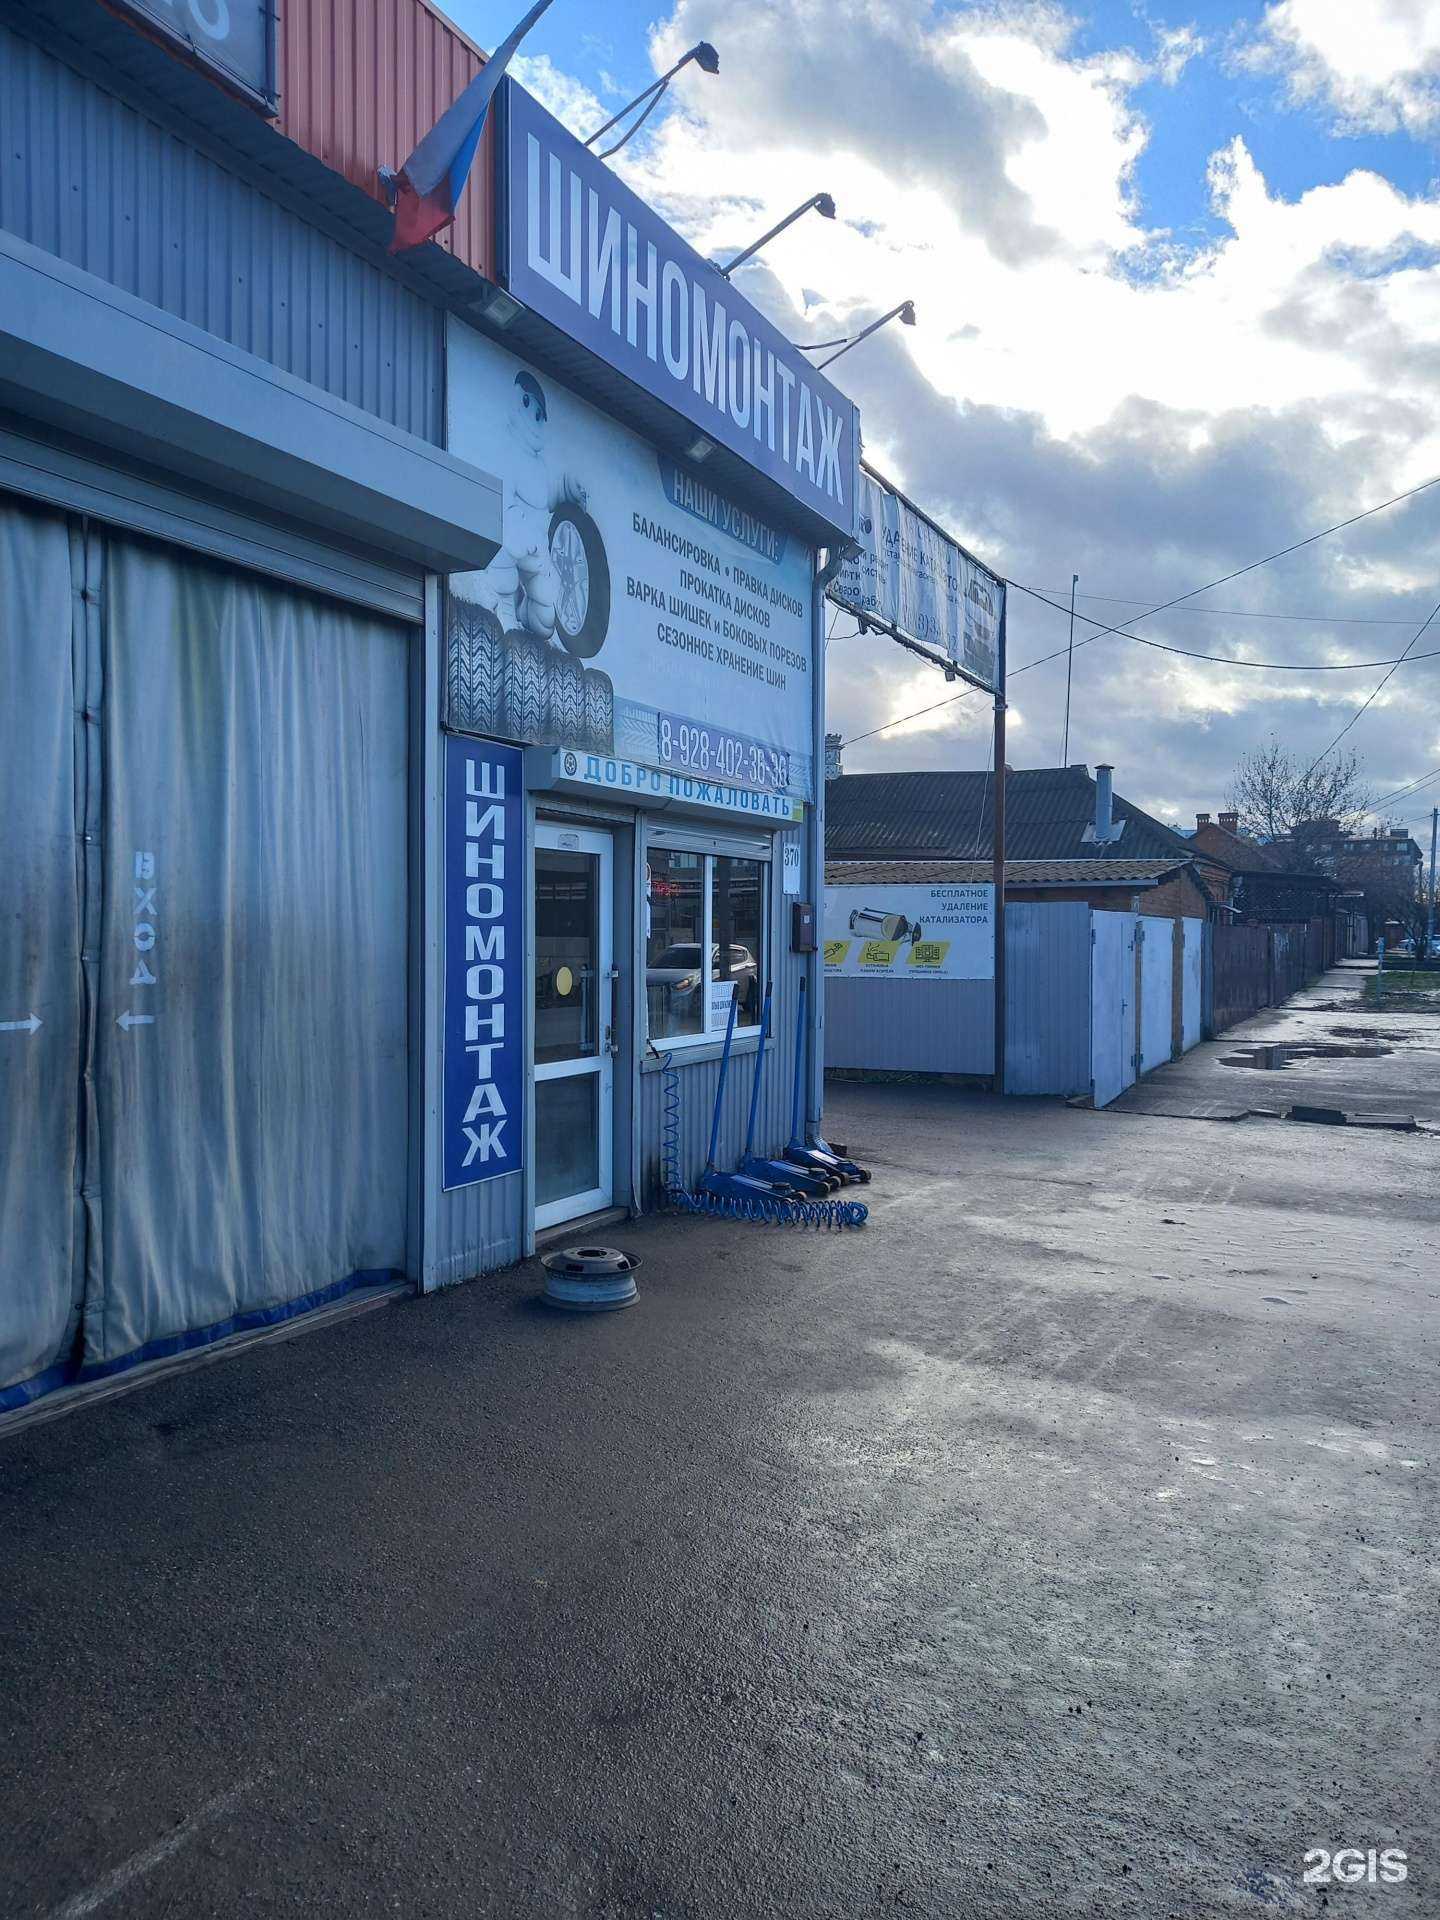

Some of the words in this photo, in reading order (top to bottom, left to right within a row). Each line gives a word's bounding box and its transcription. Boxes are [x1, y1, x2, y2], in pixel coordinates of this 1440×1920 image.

[527, 132, 844, 505] ШИНОМОНТАЖ
[673, 469, 718, 524] НАШИ
[632, 512, 721, 576] БАЛАНСИРОВКА
[733, 566, 769, 602] ПРАВКА
[769, 588, 803, 618] ДИСКОВ
[626, 576, 666, 611] ВАРКА
[669, 595, 711, 631] ШИШЕК
[722, 619, 768, 656] БОКОВЫХ
[769, 642, 807, 672] ПОРЕЗОВ
[680, 568, 732, 611] ПРОКАТКА
[734, 596, 770, 628] ДИСКОВ
[657, 622, 714, 661] СЕЗОННОЕ
[716, 649, 765, 682] ХРАНЕНИЕ
[766, 667, 786, 691] ШИН
[584, 755, 662, 792] ДОБРО
[669, 775, 790, 816] ПОЖАЛОВАТЬ
[784, 847, 799, 867] 370
[129, 851, 158, 985] ВХОД
[919, 915, 989, 924] КАТАЛИЗАТОРА
[930, 889, 989, 898] БЕСПЛАТНОЕ
[941, 902, 989, 912] УДАЛЕНИЕ
[461, 758, 508, 1168] ШИНОМОНТАЖ
